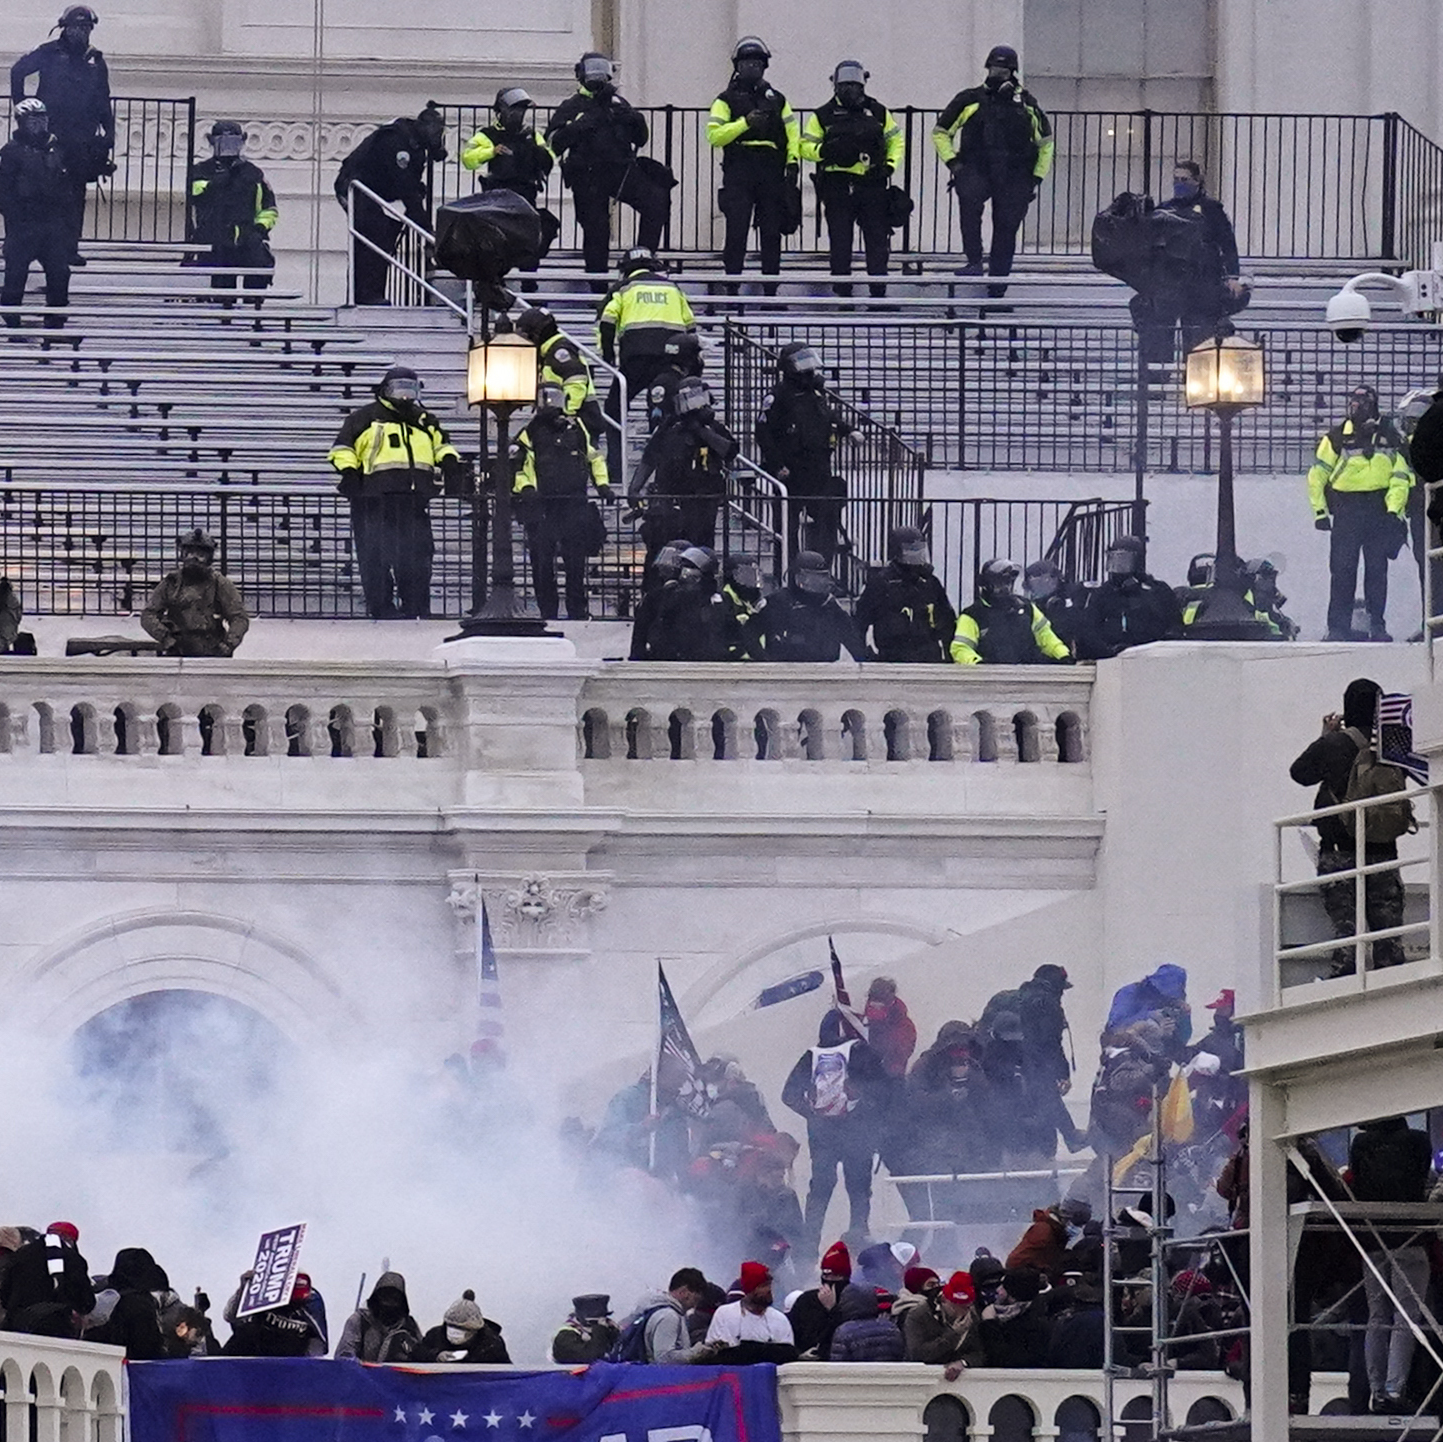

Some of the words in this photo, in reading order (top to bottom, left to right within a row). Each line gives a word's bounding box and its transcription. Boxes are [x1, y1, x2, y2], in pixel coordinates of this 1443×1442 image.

[636, 291, 669, 305] POLICE
[249, 1250, 270, 1295] 2020
[265, 1229, 296, 1303] TRUMP
